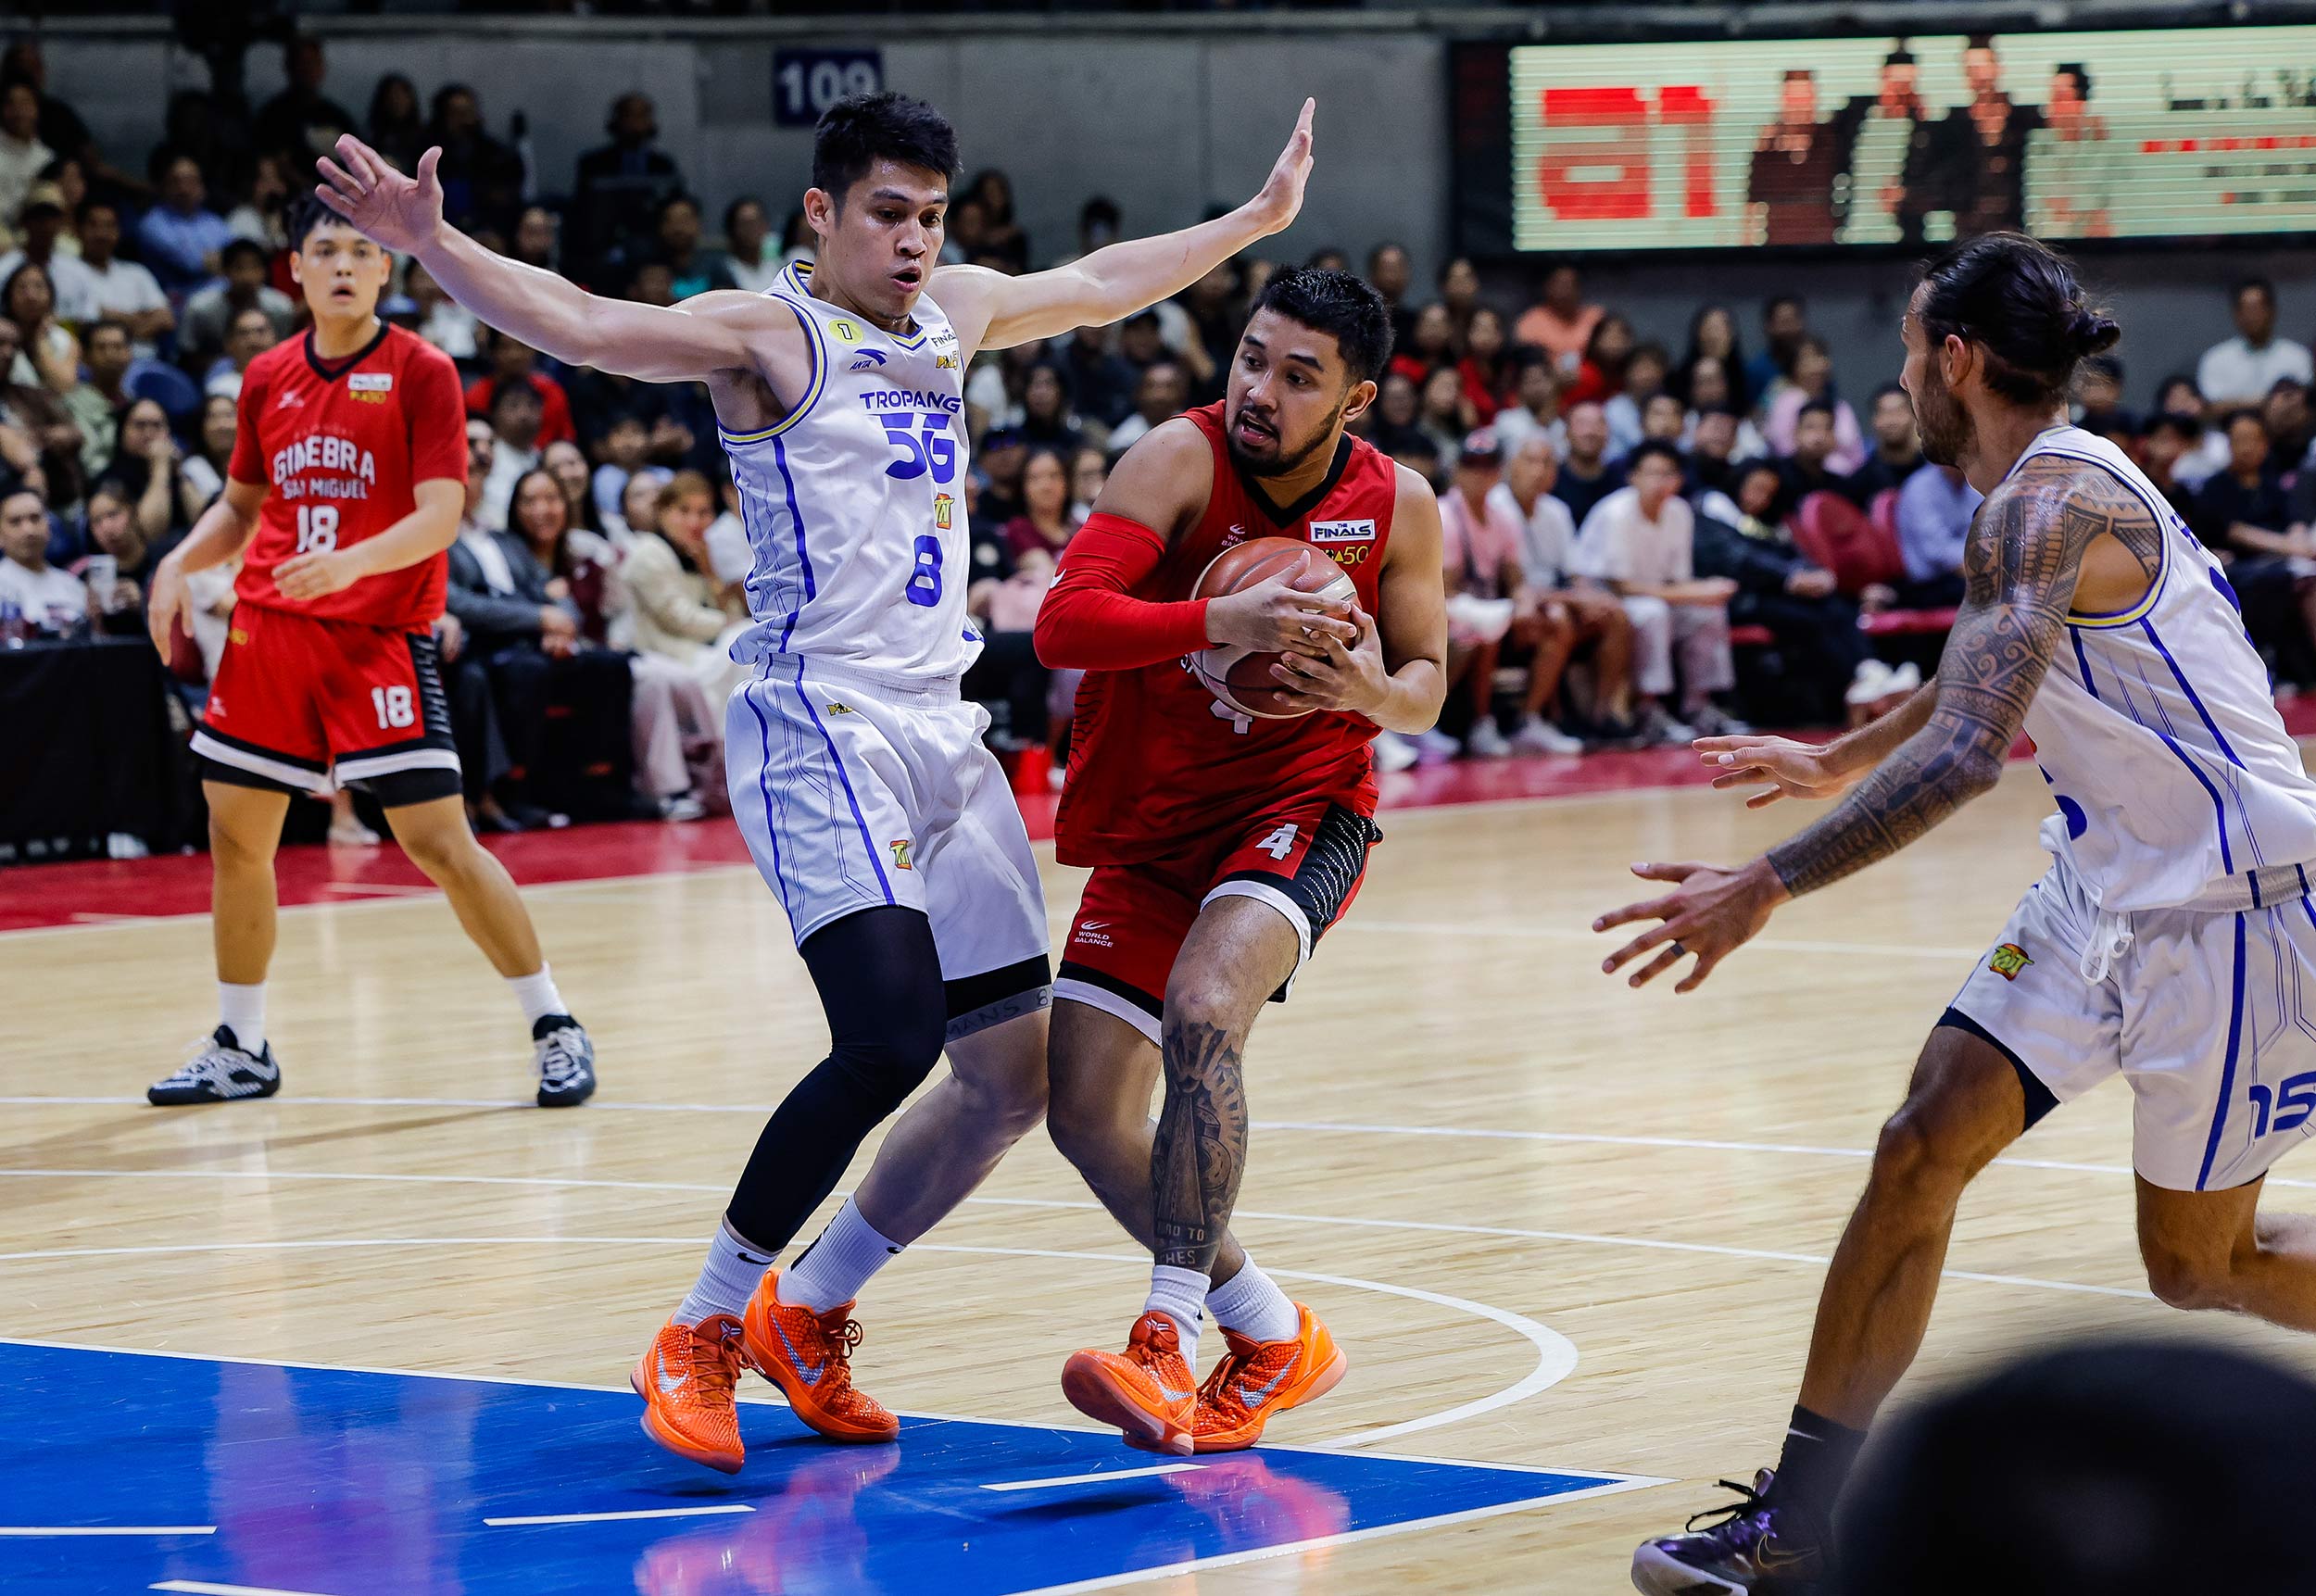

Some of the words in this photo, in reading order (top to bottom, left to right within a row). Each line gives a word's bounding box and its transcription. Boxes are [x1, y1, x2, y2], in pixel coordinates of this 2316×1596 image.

[779, 59, 875, 112] 109
[860, 390, 962, 414] TROPANG
[273, 435, 375, 485] GINEBRA
[877, 412, 954, 484] 5G
[309, 478, 368, 499] MIGUEL
[296, 505, 339, 554] 18
[1315, 525, 1371, 539] FINALS
[905, 534, 943, 608] 8
[371, 685, 415, 729] 18
[1255, 823, 1299, 861] 4
[1075, 936, 1114, 948] BALANCE
[1078, 931, 1110, 940] WORLD
[2249, 1071, 2316, 1139] 15
[1188, 1226, 1204, 1241] TO
